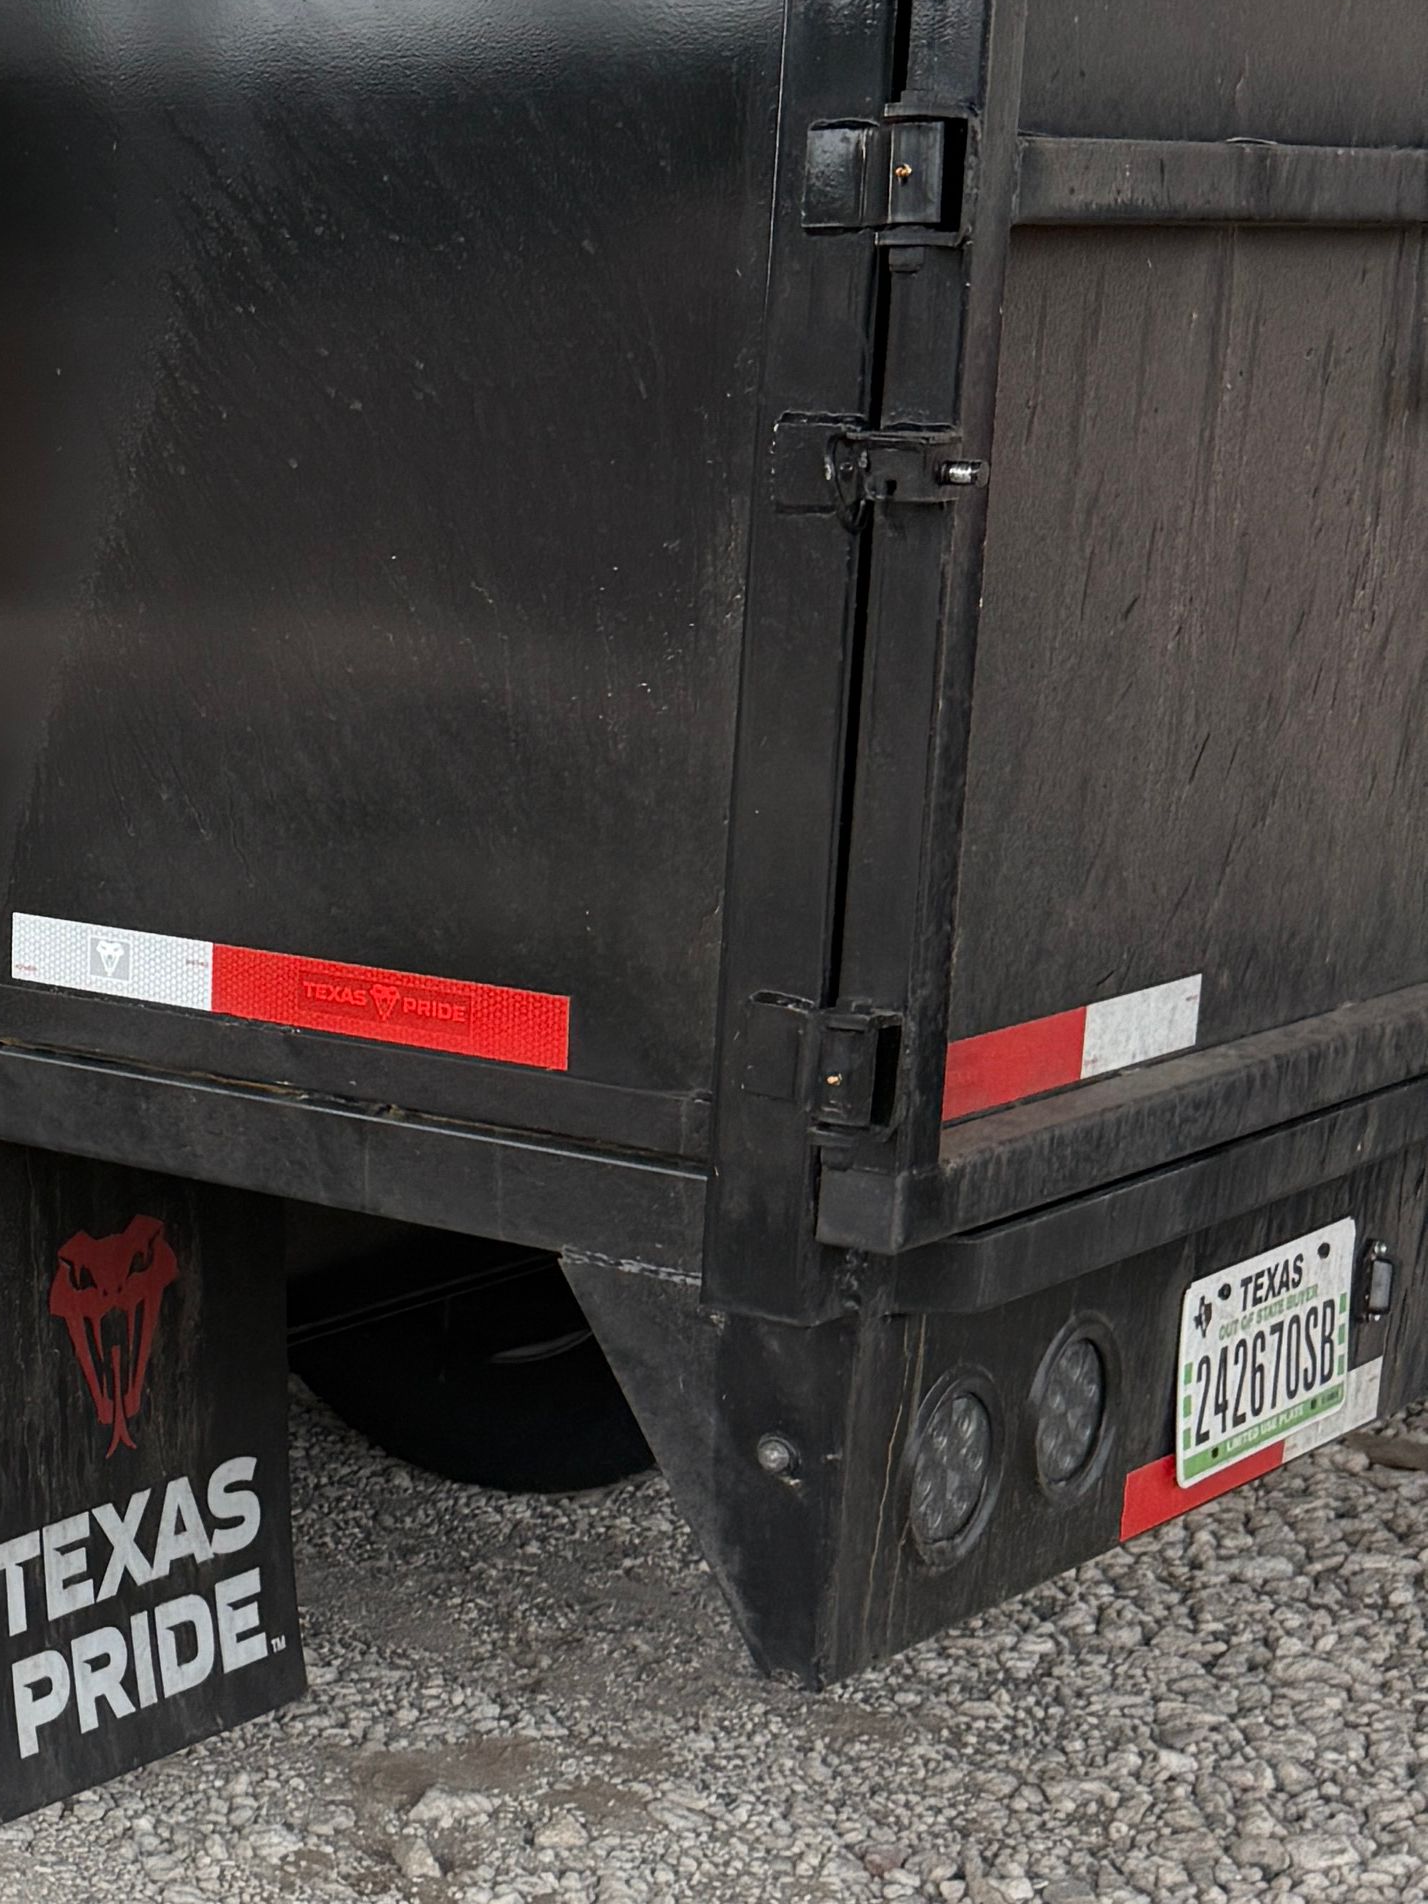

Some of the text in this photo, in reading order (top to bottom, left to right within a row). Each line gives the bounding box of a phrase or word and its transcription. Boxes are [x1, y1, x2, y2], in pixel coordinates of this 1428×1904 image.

[302, 980, 467, 1023] TEXAS PRIDE
[1240, 1254, 1304, 1311] TEXAS
[1219, 1318, 1240, 1341] OUT
[1240, 1312, 1255, 1331] OF
[1256, 1298, 1284, 1324] STATE
[1195, 1299, 1336, 1446] 242670SB
[1226, 1403, 1304, 1451] LIMITED USE PLATE
[11, 1566, 268, 1760] PRIDE
